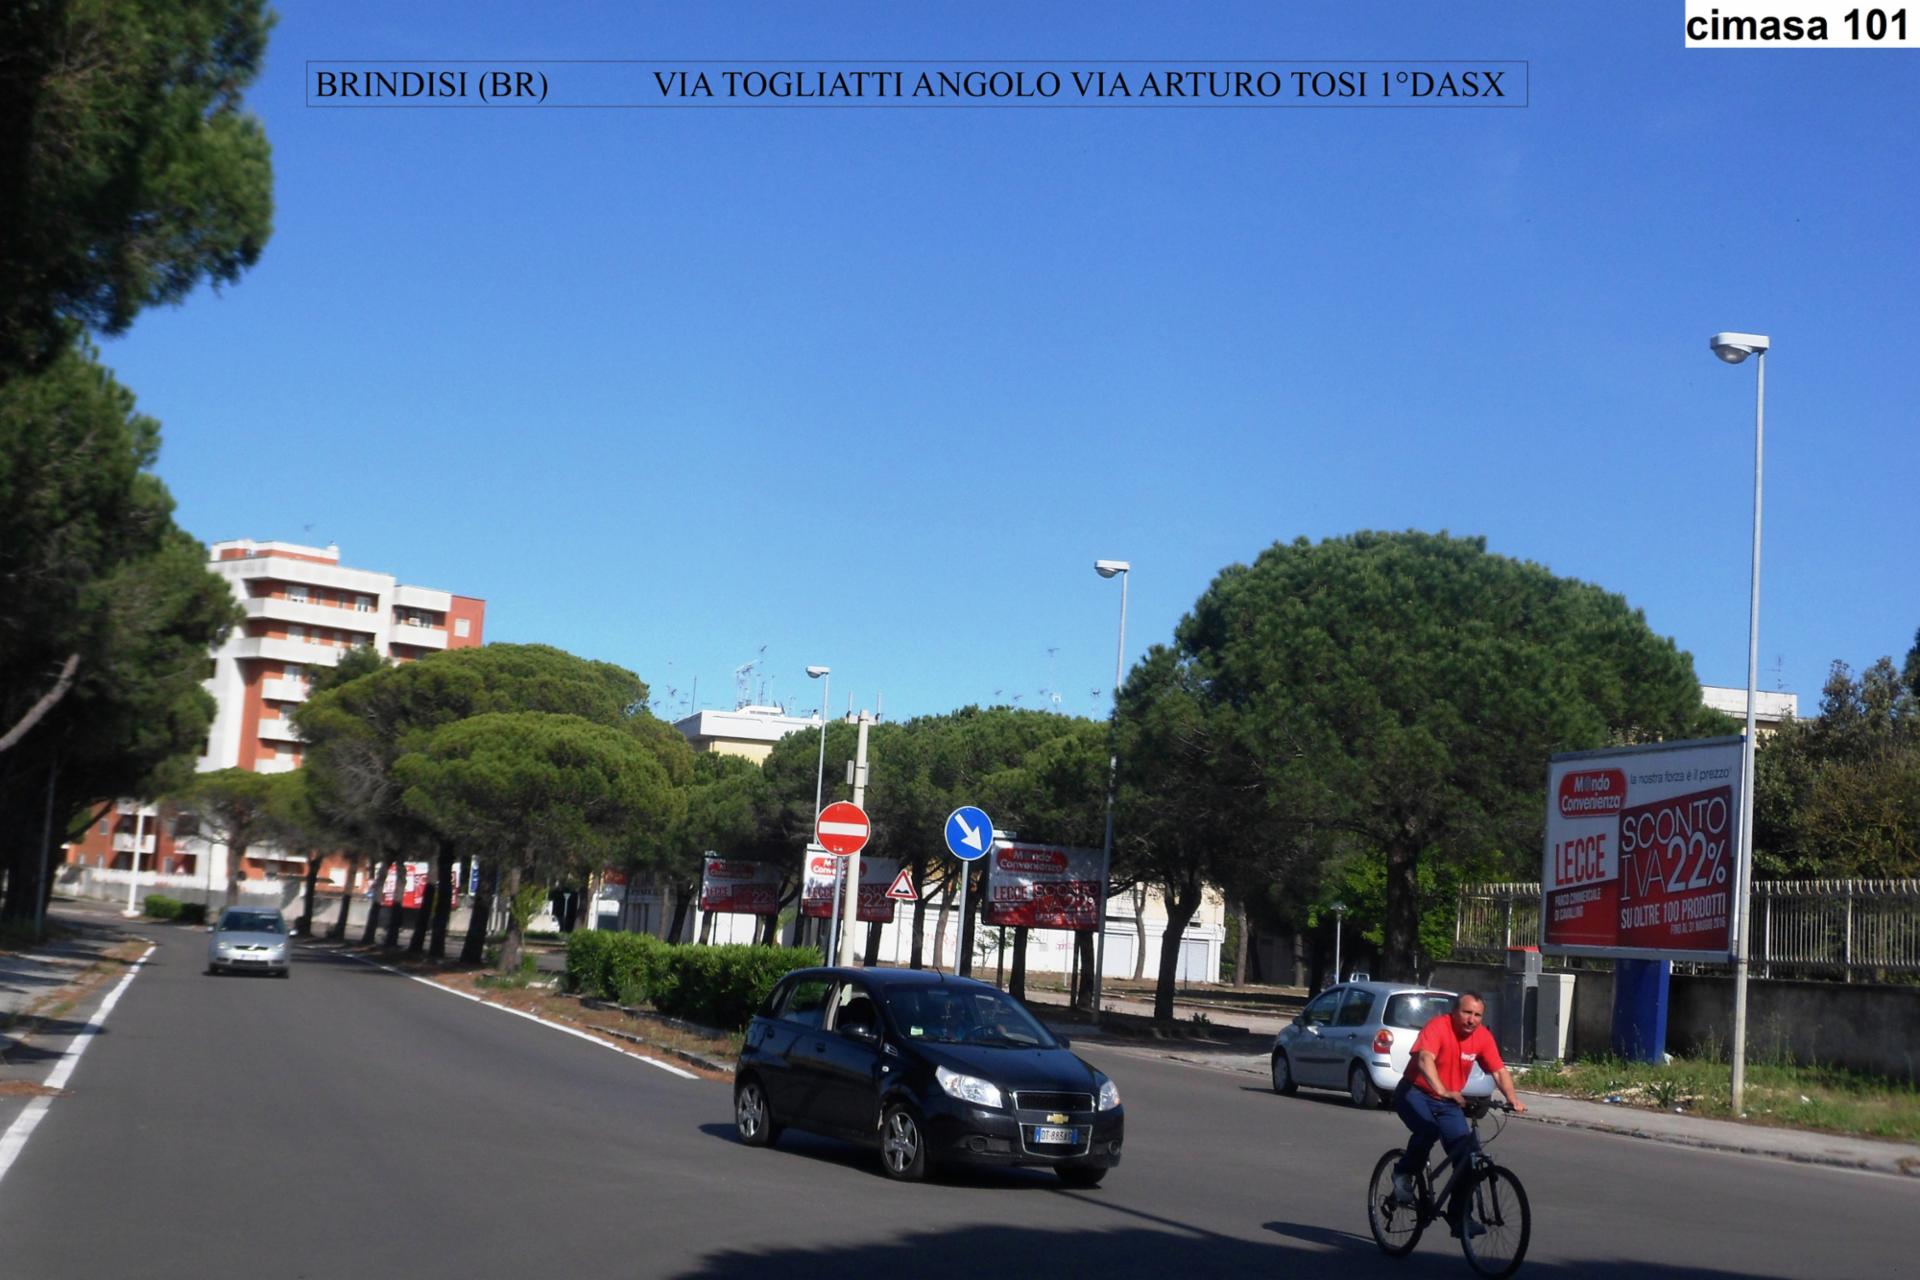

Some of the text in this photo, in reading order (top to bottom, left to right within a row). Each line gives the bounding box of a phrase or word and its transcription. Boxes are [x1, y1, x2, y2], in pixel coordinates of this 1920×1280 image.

[1574, 773, 1610, 793] Mondo
[1630, 773, 1637, 785] la
[1639, 772, 1663, 785] nostra
[1665, 770, 1685, 783] forza
[1699, 768, 1730, 784] prezzo
[1561, 791, 1621, 812] Convenienza
[1621, 796, 1727, 853] SCONTO
[1555, 833, 1607, 887] LECCE
[1621, 831, 1726, 901] IVA 22%
[1621, 892, 1726, 930] SU OLTRE 100 PRODOTTI
